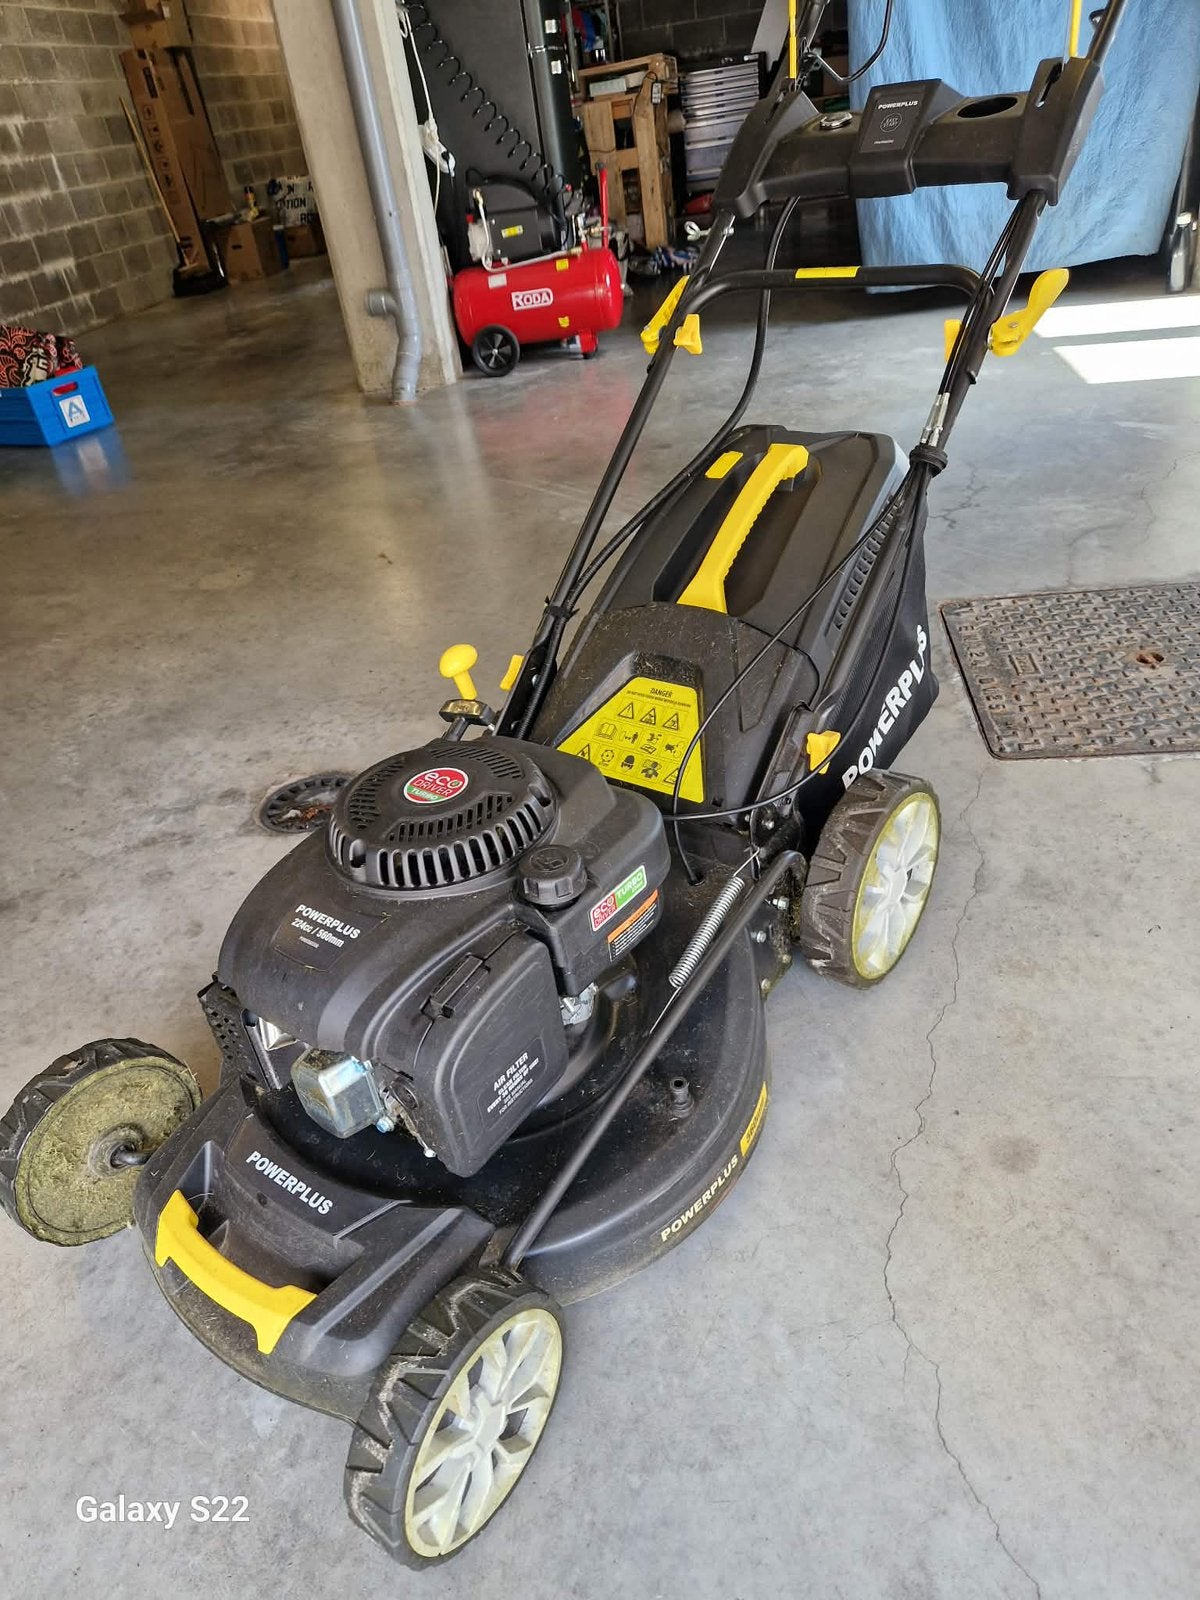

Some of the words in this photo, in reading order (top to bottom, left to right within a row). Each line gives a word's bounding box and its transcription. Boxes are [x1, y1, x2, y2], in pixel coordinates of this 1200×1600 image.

[878, 101, 918, 109] POWERPLUS
[650, 687, 673, 698] DANGER
[411, 787, 439, 800] TURBO
[413, 779, 453, 796] DRIVER
[424, 772, 463, 789] eco
[593, 895, 615, 918] eco
[617, 872, 643, 899] TURBO
[291, 917, 313, 933] 224cc
[316, 928, 345, 948] 560mm
[295, 904, 361, 939] POWERPLUS
[594, 905, 616, 929] DRIVER
[494, 1075, 505, 1091] AIR
[506, 1052, 528, 1078] FILTER
[499, 1104, 508, 1115] FOR
[507, 1078, 533, 1106] INSTRUCTIONS
[245, 1150, 334, 1215] POWERPLUS
[660, 1154, 739, 1242] POWERPLUS
